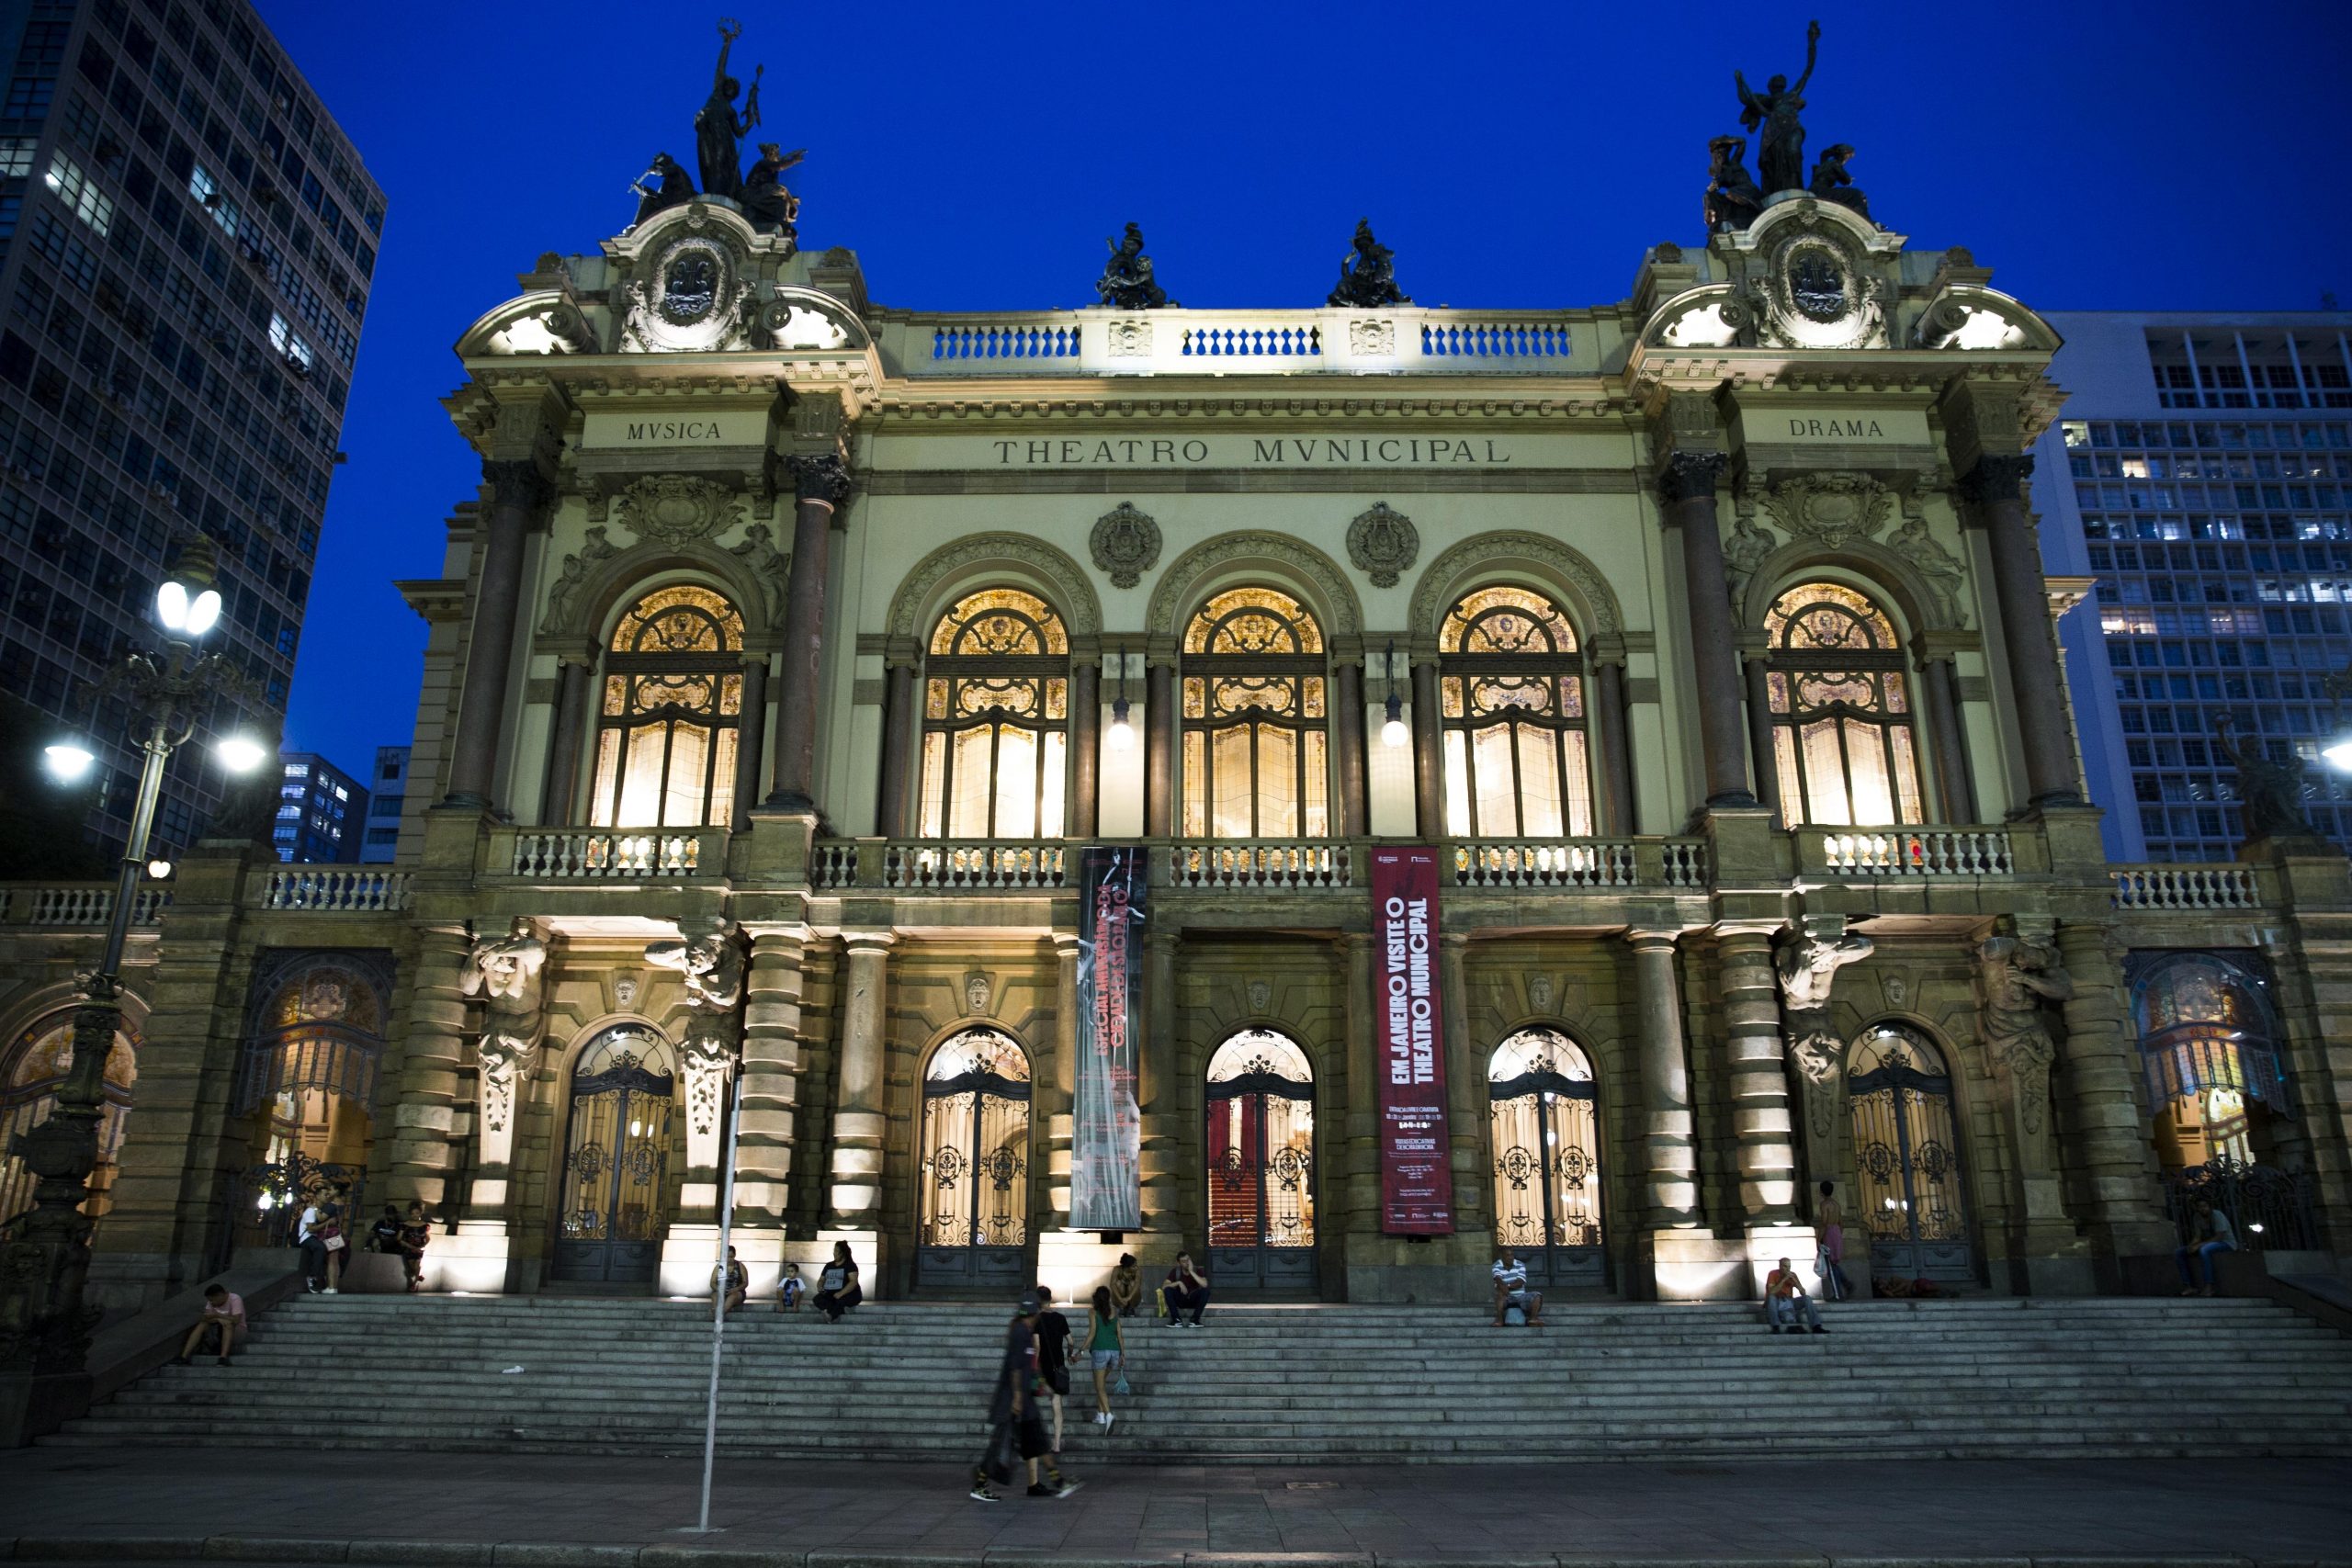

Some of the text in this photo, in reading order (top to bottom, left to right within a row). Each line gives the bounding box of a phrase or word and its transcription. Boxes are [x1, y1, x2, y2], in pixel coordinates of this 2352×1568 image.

[628, 422, 721, 440] MVSICA
[993, 438, 1511, 464] THEATRO MVNICIPAL
[1789, 419, 1884, 437] DRAMA
[1408, 897, 1430, 997] MUNICIPAL
[1385, 897, 1410, 1085] EM JANEIRO VISITE O
[1094, 993, 1109, 1056] ESPECIAL
[1411, 998, 1434, 1085] THEATRO
